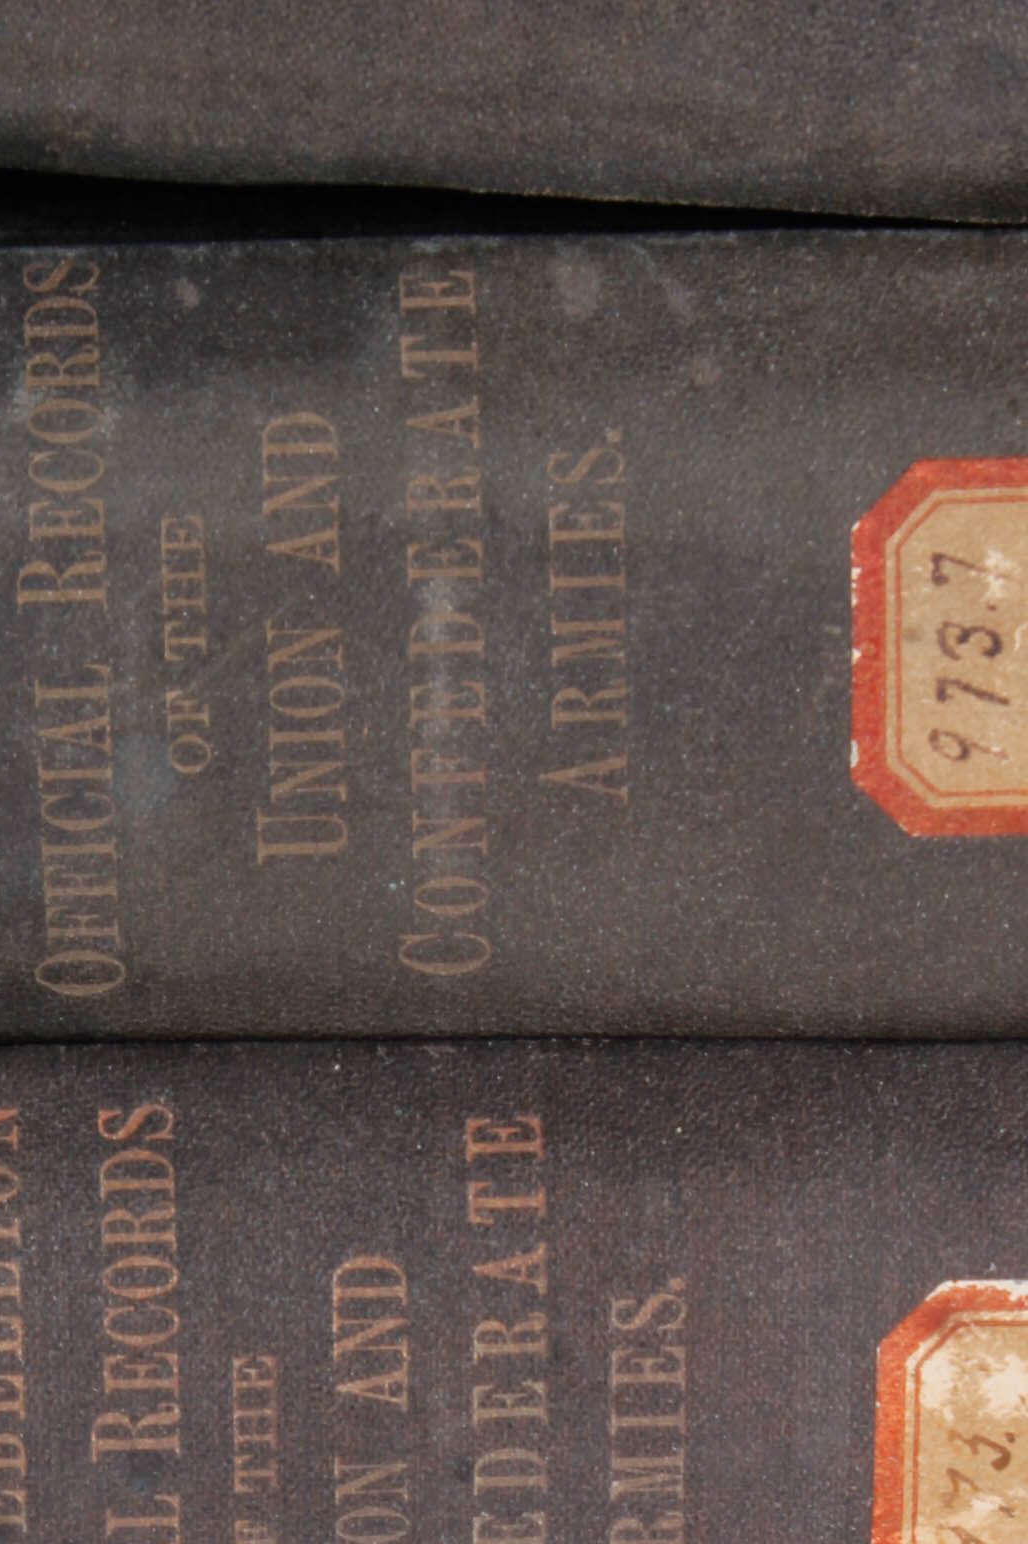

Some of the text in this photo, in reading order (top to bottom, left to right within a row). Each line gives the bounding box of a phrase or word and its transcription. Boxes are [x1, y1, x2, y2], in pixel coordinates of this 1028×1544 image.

[15, 256, 127, 996] OFFICIAL RECORDS
[160, 512, 214, 773] OF THE
[256, 408, 350, 864] UNION AND
[398, 267, 492, 977] CONFEDERATE
[539, 426, 630, 805] ARMIES.
[927, 551, 1011, 761] 973.7
[89, 1098, 185, 1462] RECORDS
[232, 1353, 278, 1492] THE
[332, 1251, 411, 1411] AND
